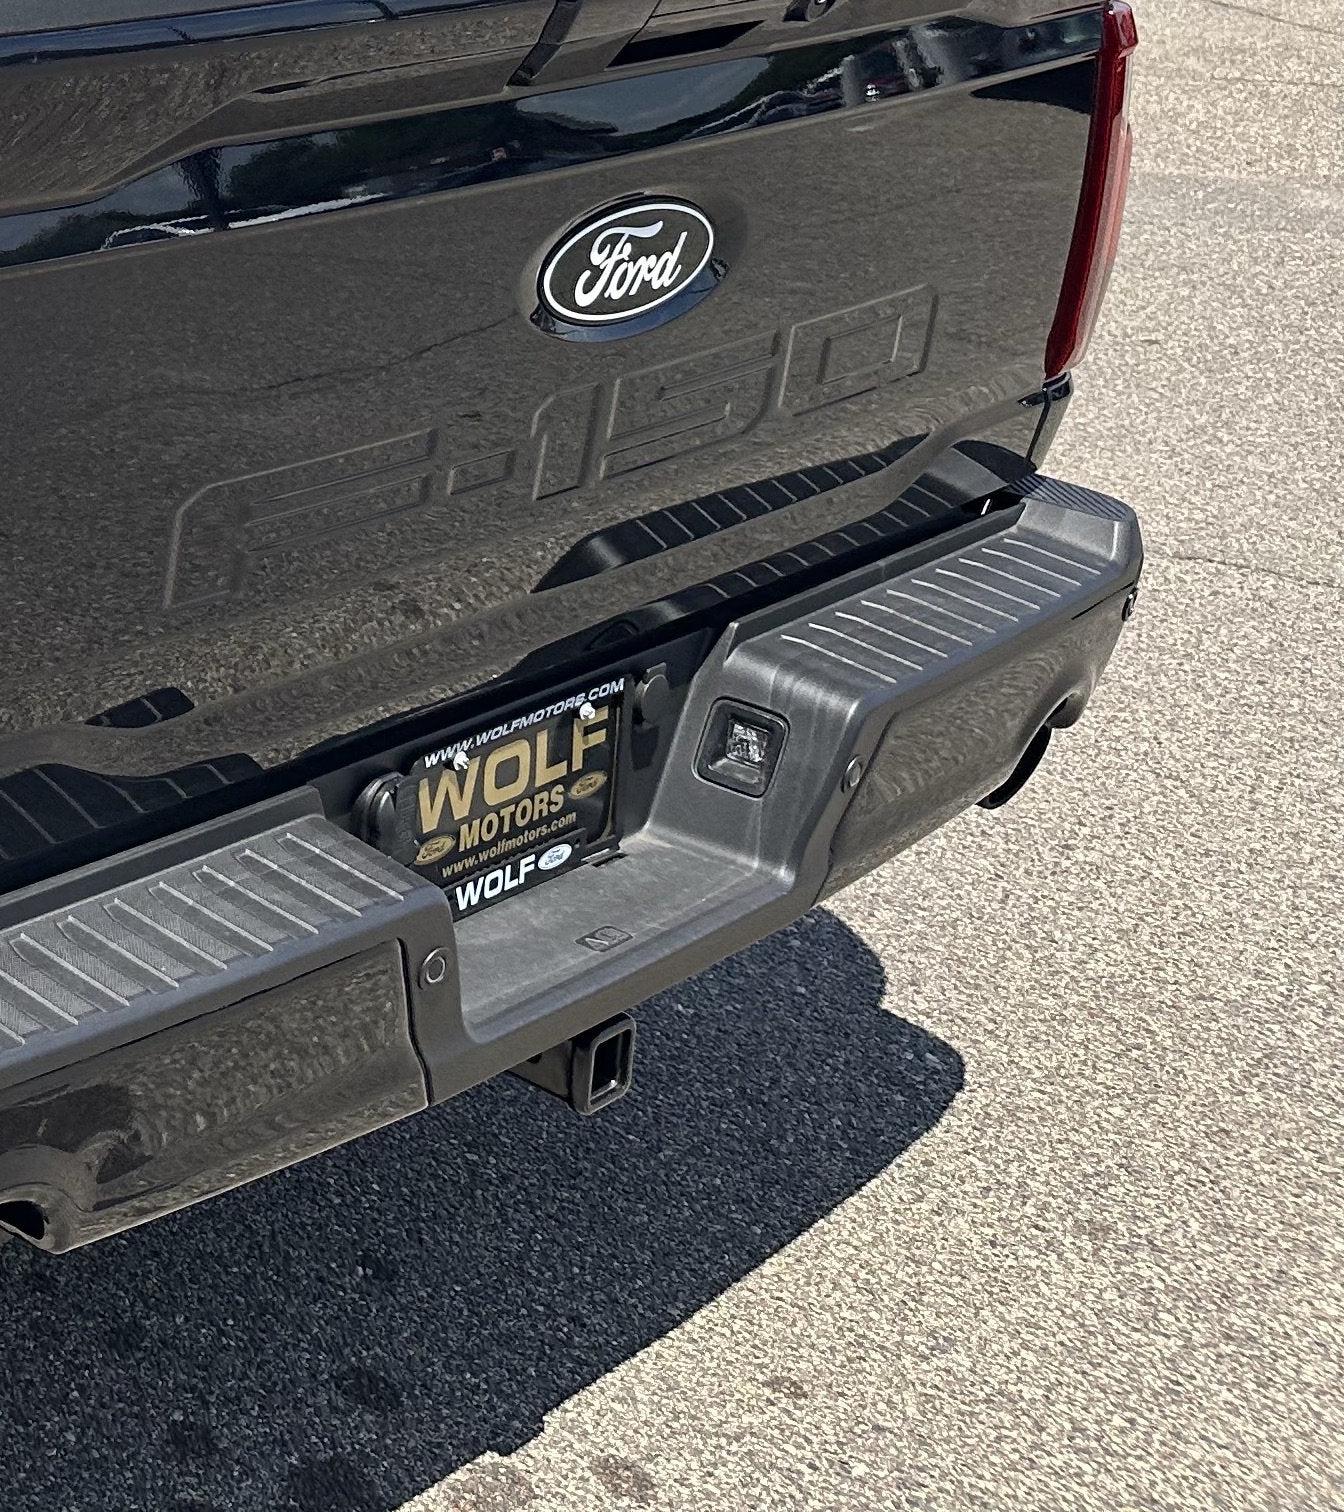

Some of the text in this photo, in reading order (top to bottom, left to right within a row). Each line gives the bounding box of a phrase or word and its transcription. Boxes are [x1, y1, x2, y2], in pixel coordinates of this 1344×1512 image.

[574, 220, 688, 307] Ford
[423, 677, 626, 769] WWW.WOLFMOTORS.COM
[417, 705, 610, 834] WOLF
[441, 811, 578, 879] www.wolfmotors.com
[458, 783, 566, 853] MOTORS
[454, 854, 536, 912] WOLF
